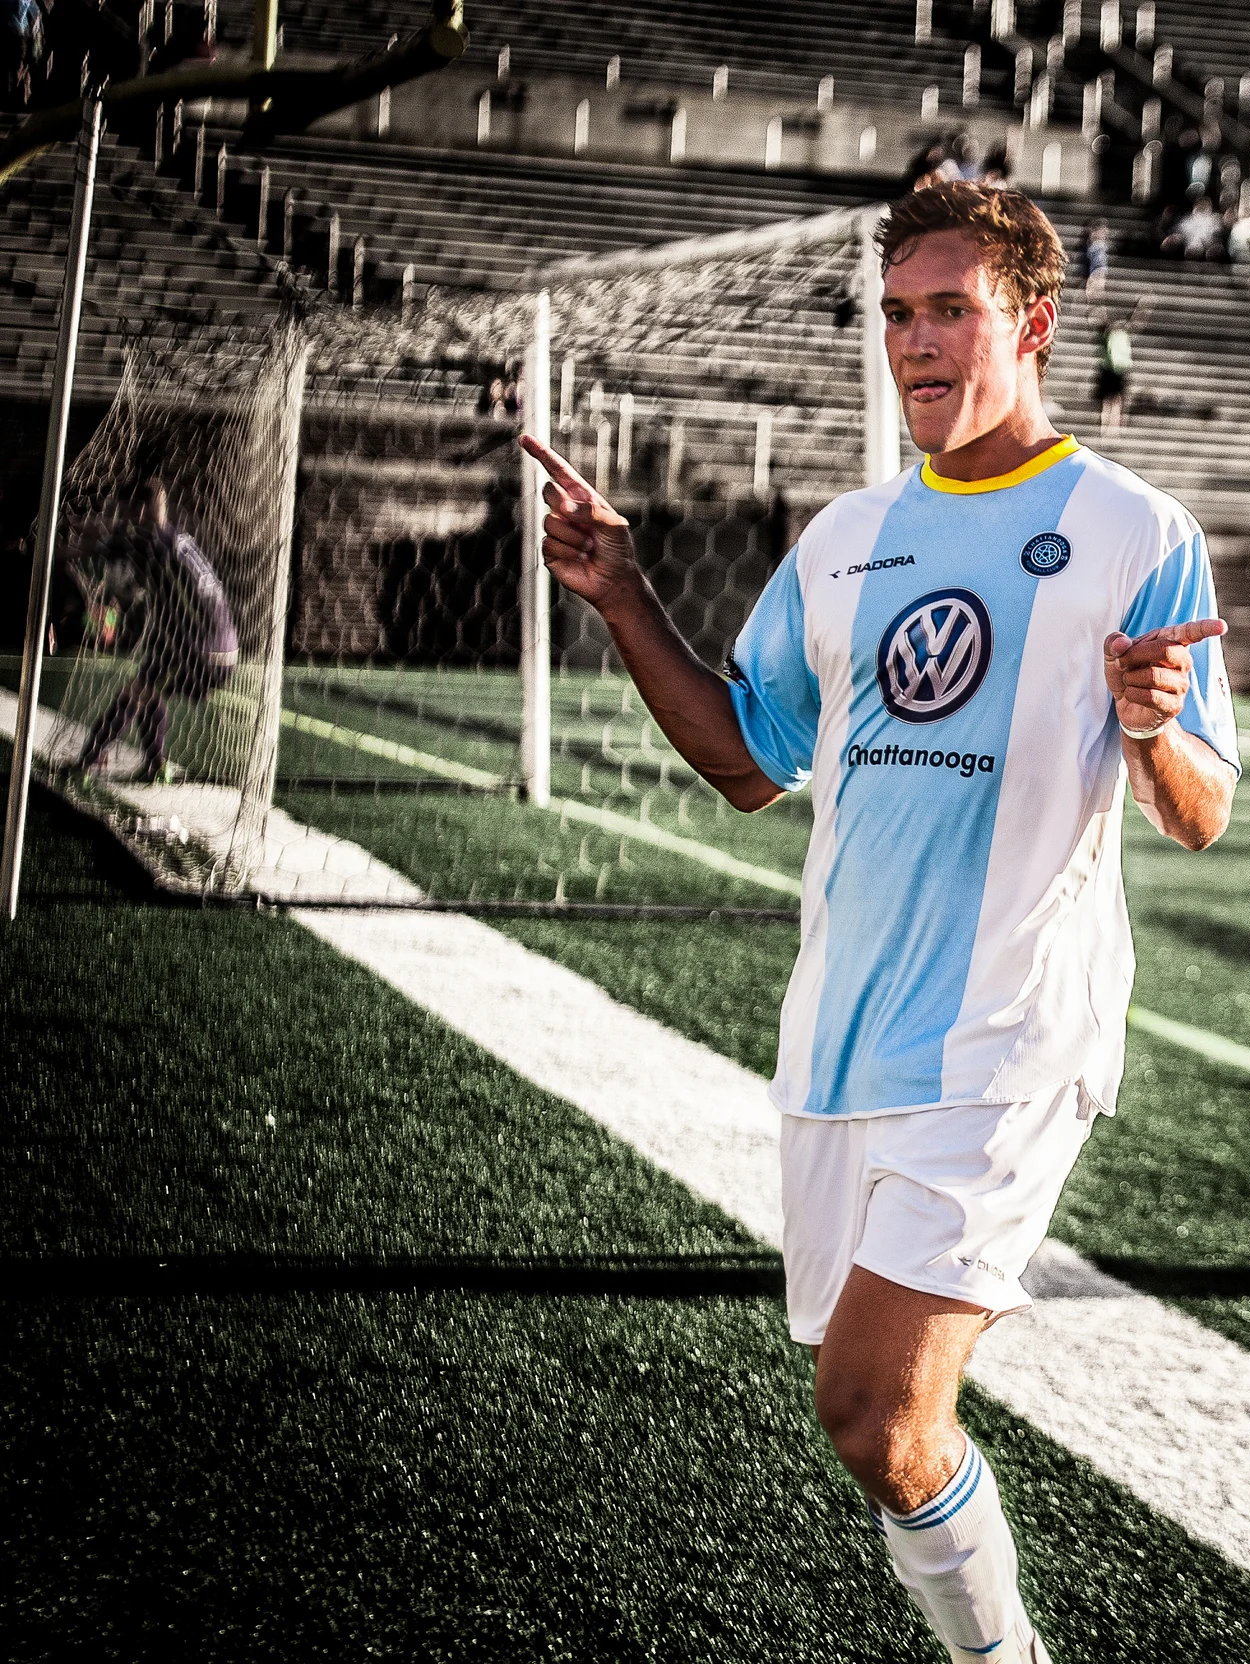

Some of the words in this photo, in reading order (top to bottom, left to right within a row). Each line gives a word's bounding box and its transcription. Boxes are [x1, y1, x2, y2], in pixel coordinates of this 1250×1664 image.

[846, 555, 916, 575] DIADORA
[885, 597, 982, 713] VW
[848, 744, 995, 778] Chattanooga
